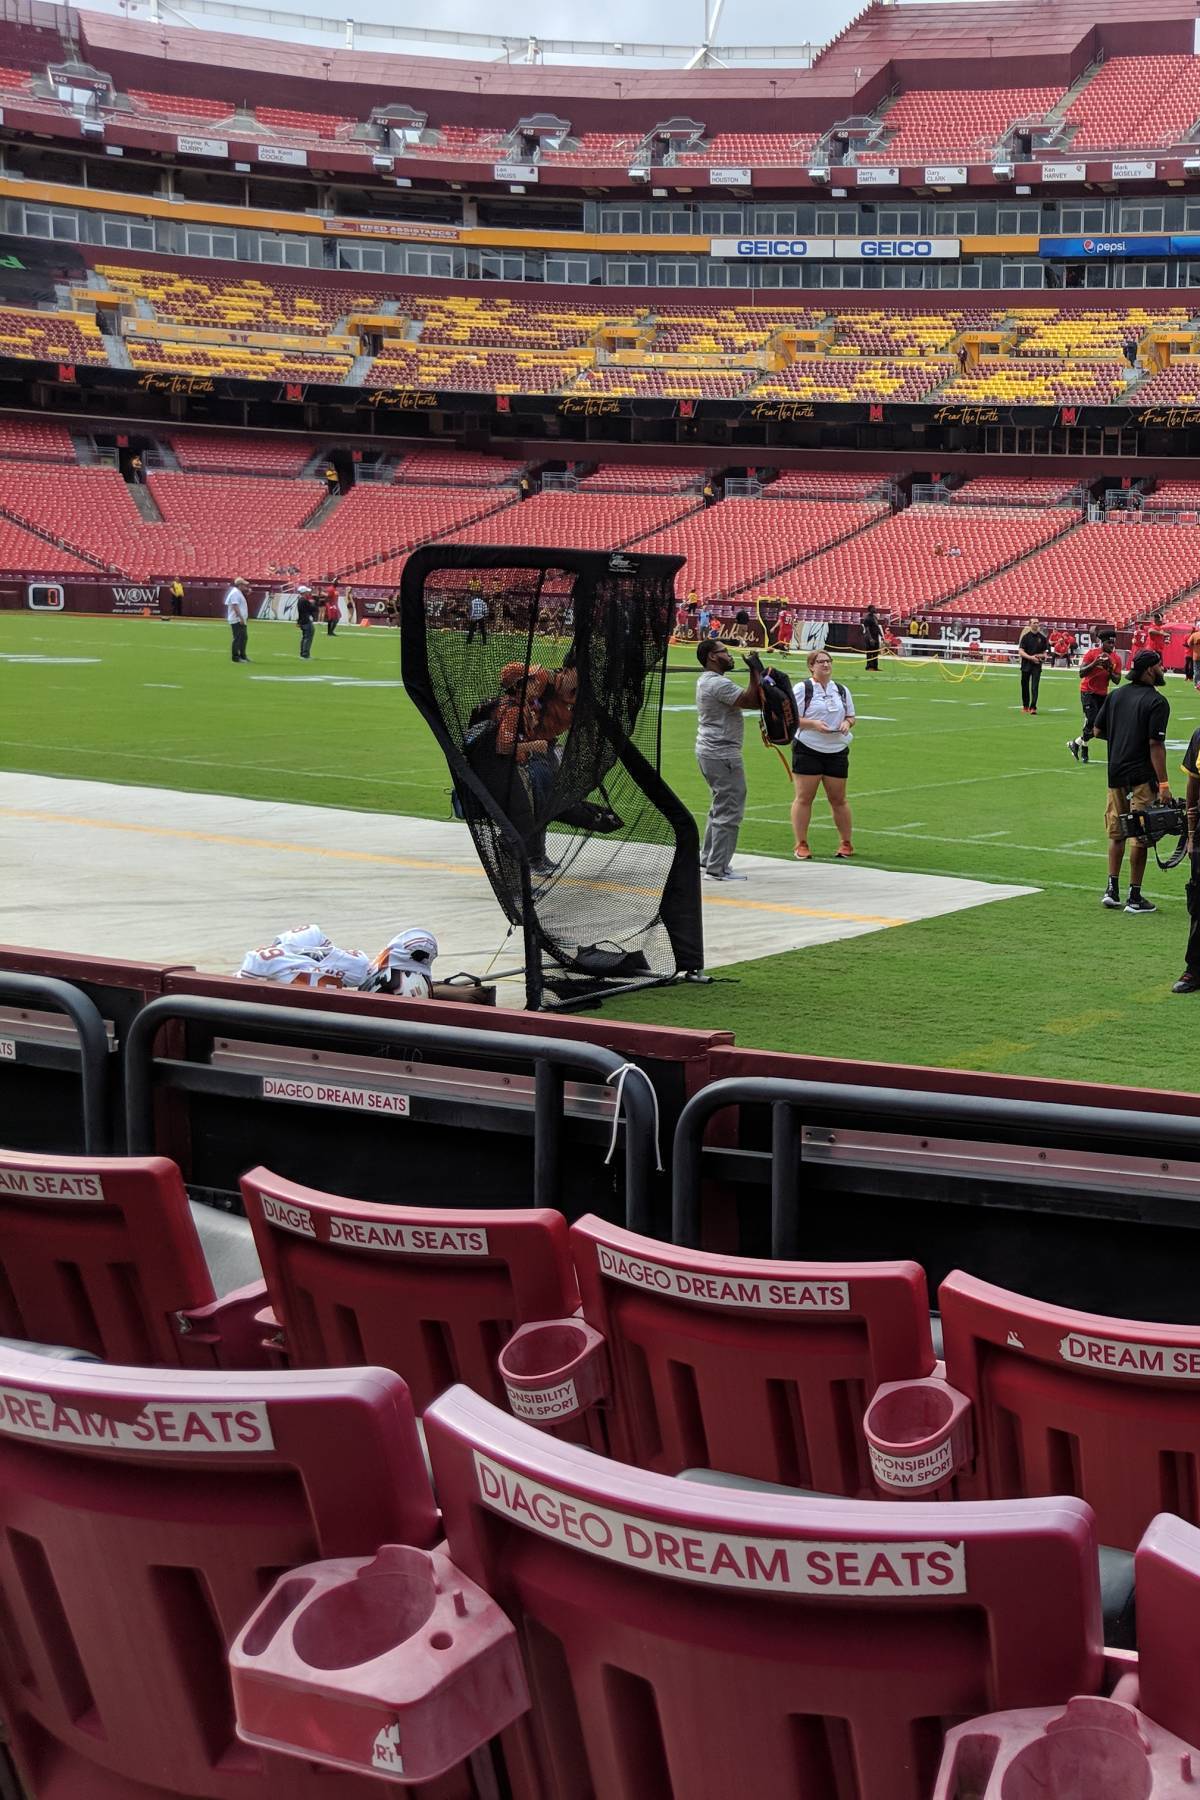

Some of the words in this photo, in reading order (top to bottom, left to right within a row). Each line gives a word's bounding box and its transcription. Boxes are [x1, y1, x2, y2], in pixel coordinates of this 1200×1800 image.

[737, 240, 807, 256] GEICO
[861, 240, 932, 256] GEICO
[1096, 240, 1126, 253] pepsi
[264, 1079, 314, 1099] DIAGEO
[316, 1087, 365, 1107] DREAM
[366, 1094, 407, 1113] SEATS
[33, 1176, 99, 1197] SEATS
[330, 1221, 406, 1249] DREAM
[412, 1229, 483, 1251] SEATS
[601, 1249, 671, 1289] DIAGEO
[676, 1275, 762, 1304] DREAM
[768, 1284, 845, 1306] SEATS
[1069, 1337, 1164, 1372] DREAM
[537, 1397, 574, 1416] SPORT
[133, 1409, 262, 1443] SEATS
[881, 1468, 914, 1483] TEAM
[918, 1458, 951, 1482] SPORT
[480, 1462, 613, 1550] DIAGEO
[624, 1521, 792, 1584] DREAM
[807, 1550, 955, 1588] SEATS
